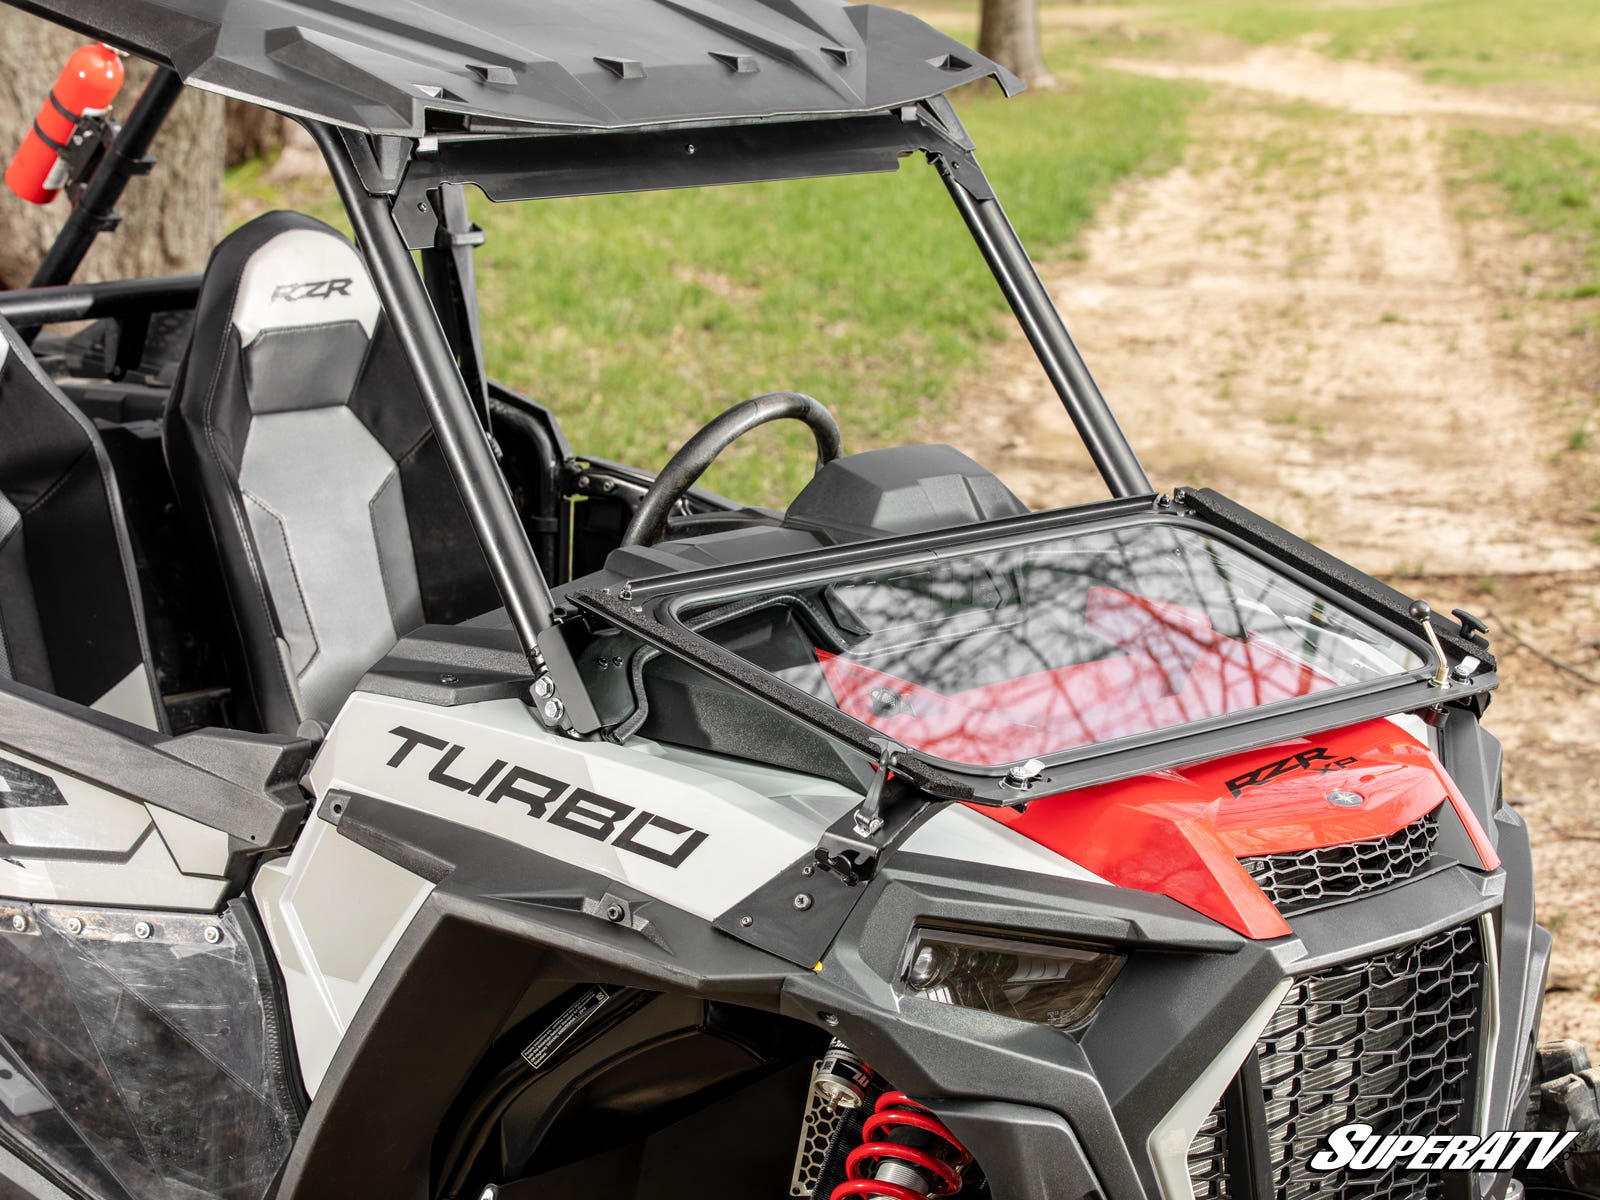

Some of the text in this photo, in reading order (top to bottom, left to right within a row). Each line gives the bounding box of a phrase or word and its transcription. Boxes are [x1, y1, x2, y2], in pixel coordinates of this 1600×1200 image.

[268, 278, 353, 305] RZR
[386, 725, 710, 869] TURBO
[1224, 747, 1358, 799] RZR XP
